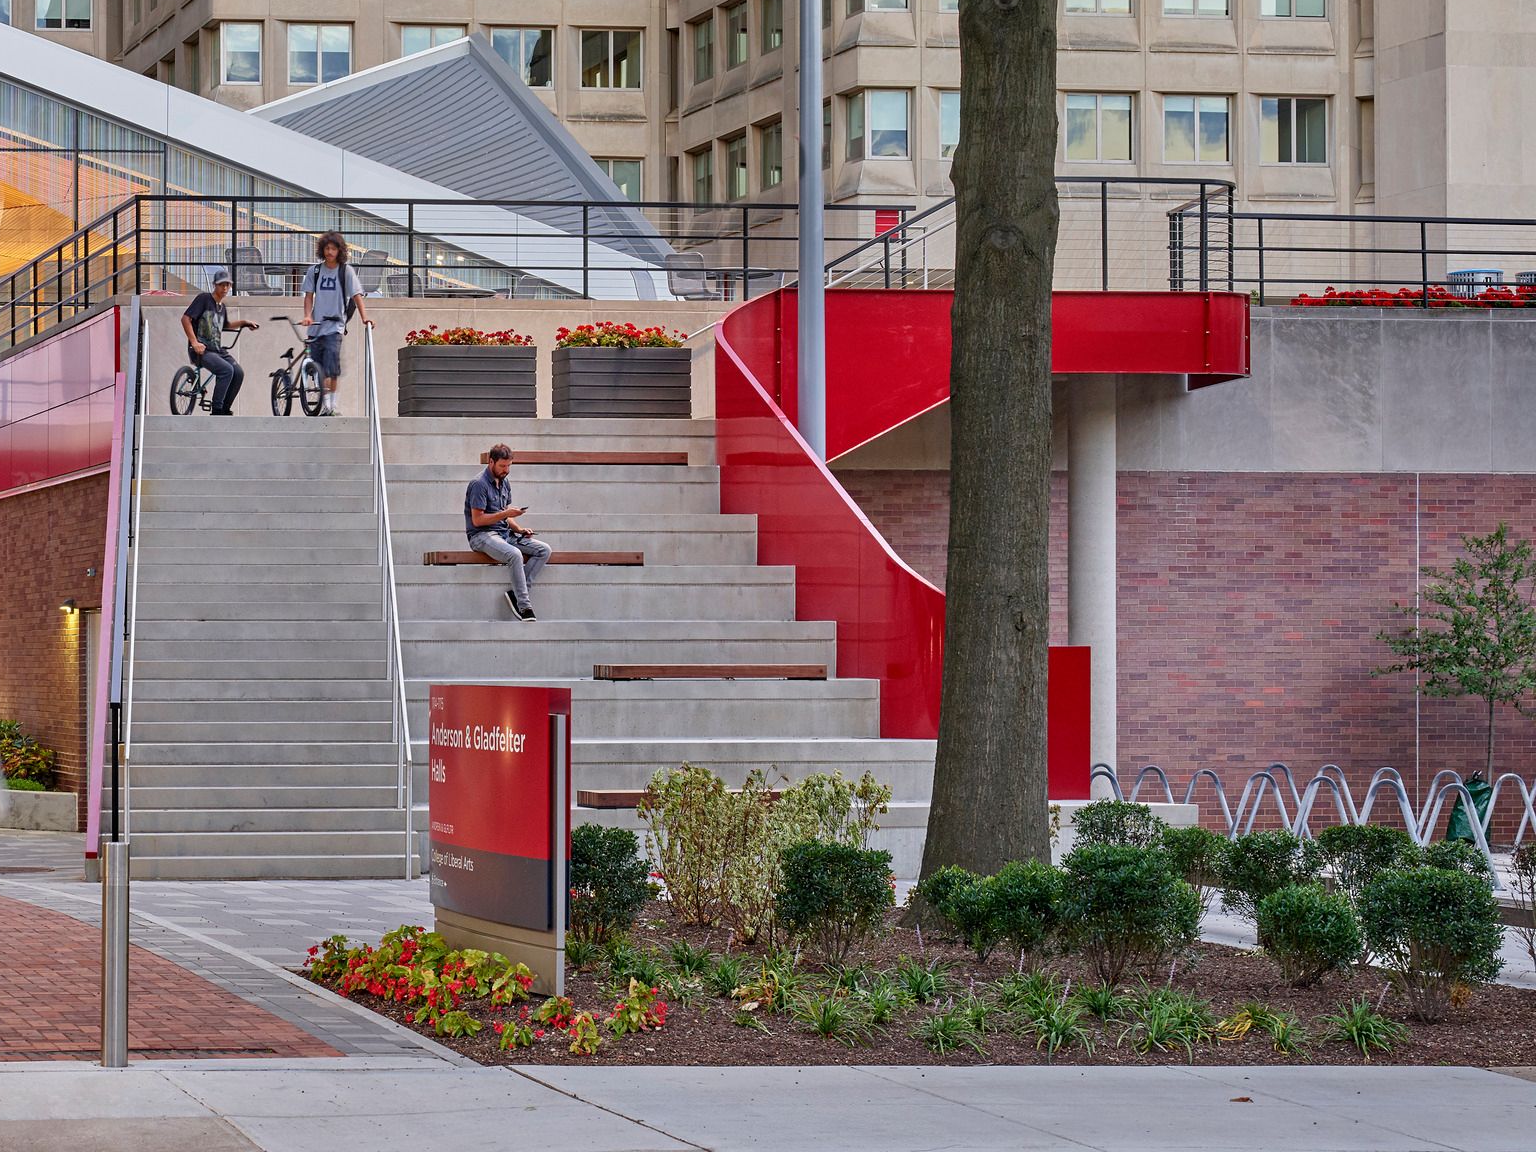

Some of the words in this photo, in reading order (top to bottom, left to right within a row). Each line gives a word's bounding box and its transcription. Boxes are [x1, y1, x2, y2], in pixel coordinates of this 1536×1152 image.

[431, 722, 463, 748] Anderson
[465, 725, 472, 749] &
[473, 725, 526, 753] Gladfelter
[431, 758, 446, 783] Halls
[444, 852, 449, 865] of
[448, 853, 463, 869] Liberal
[463, 856, 474, 872] Arts
